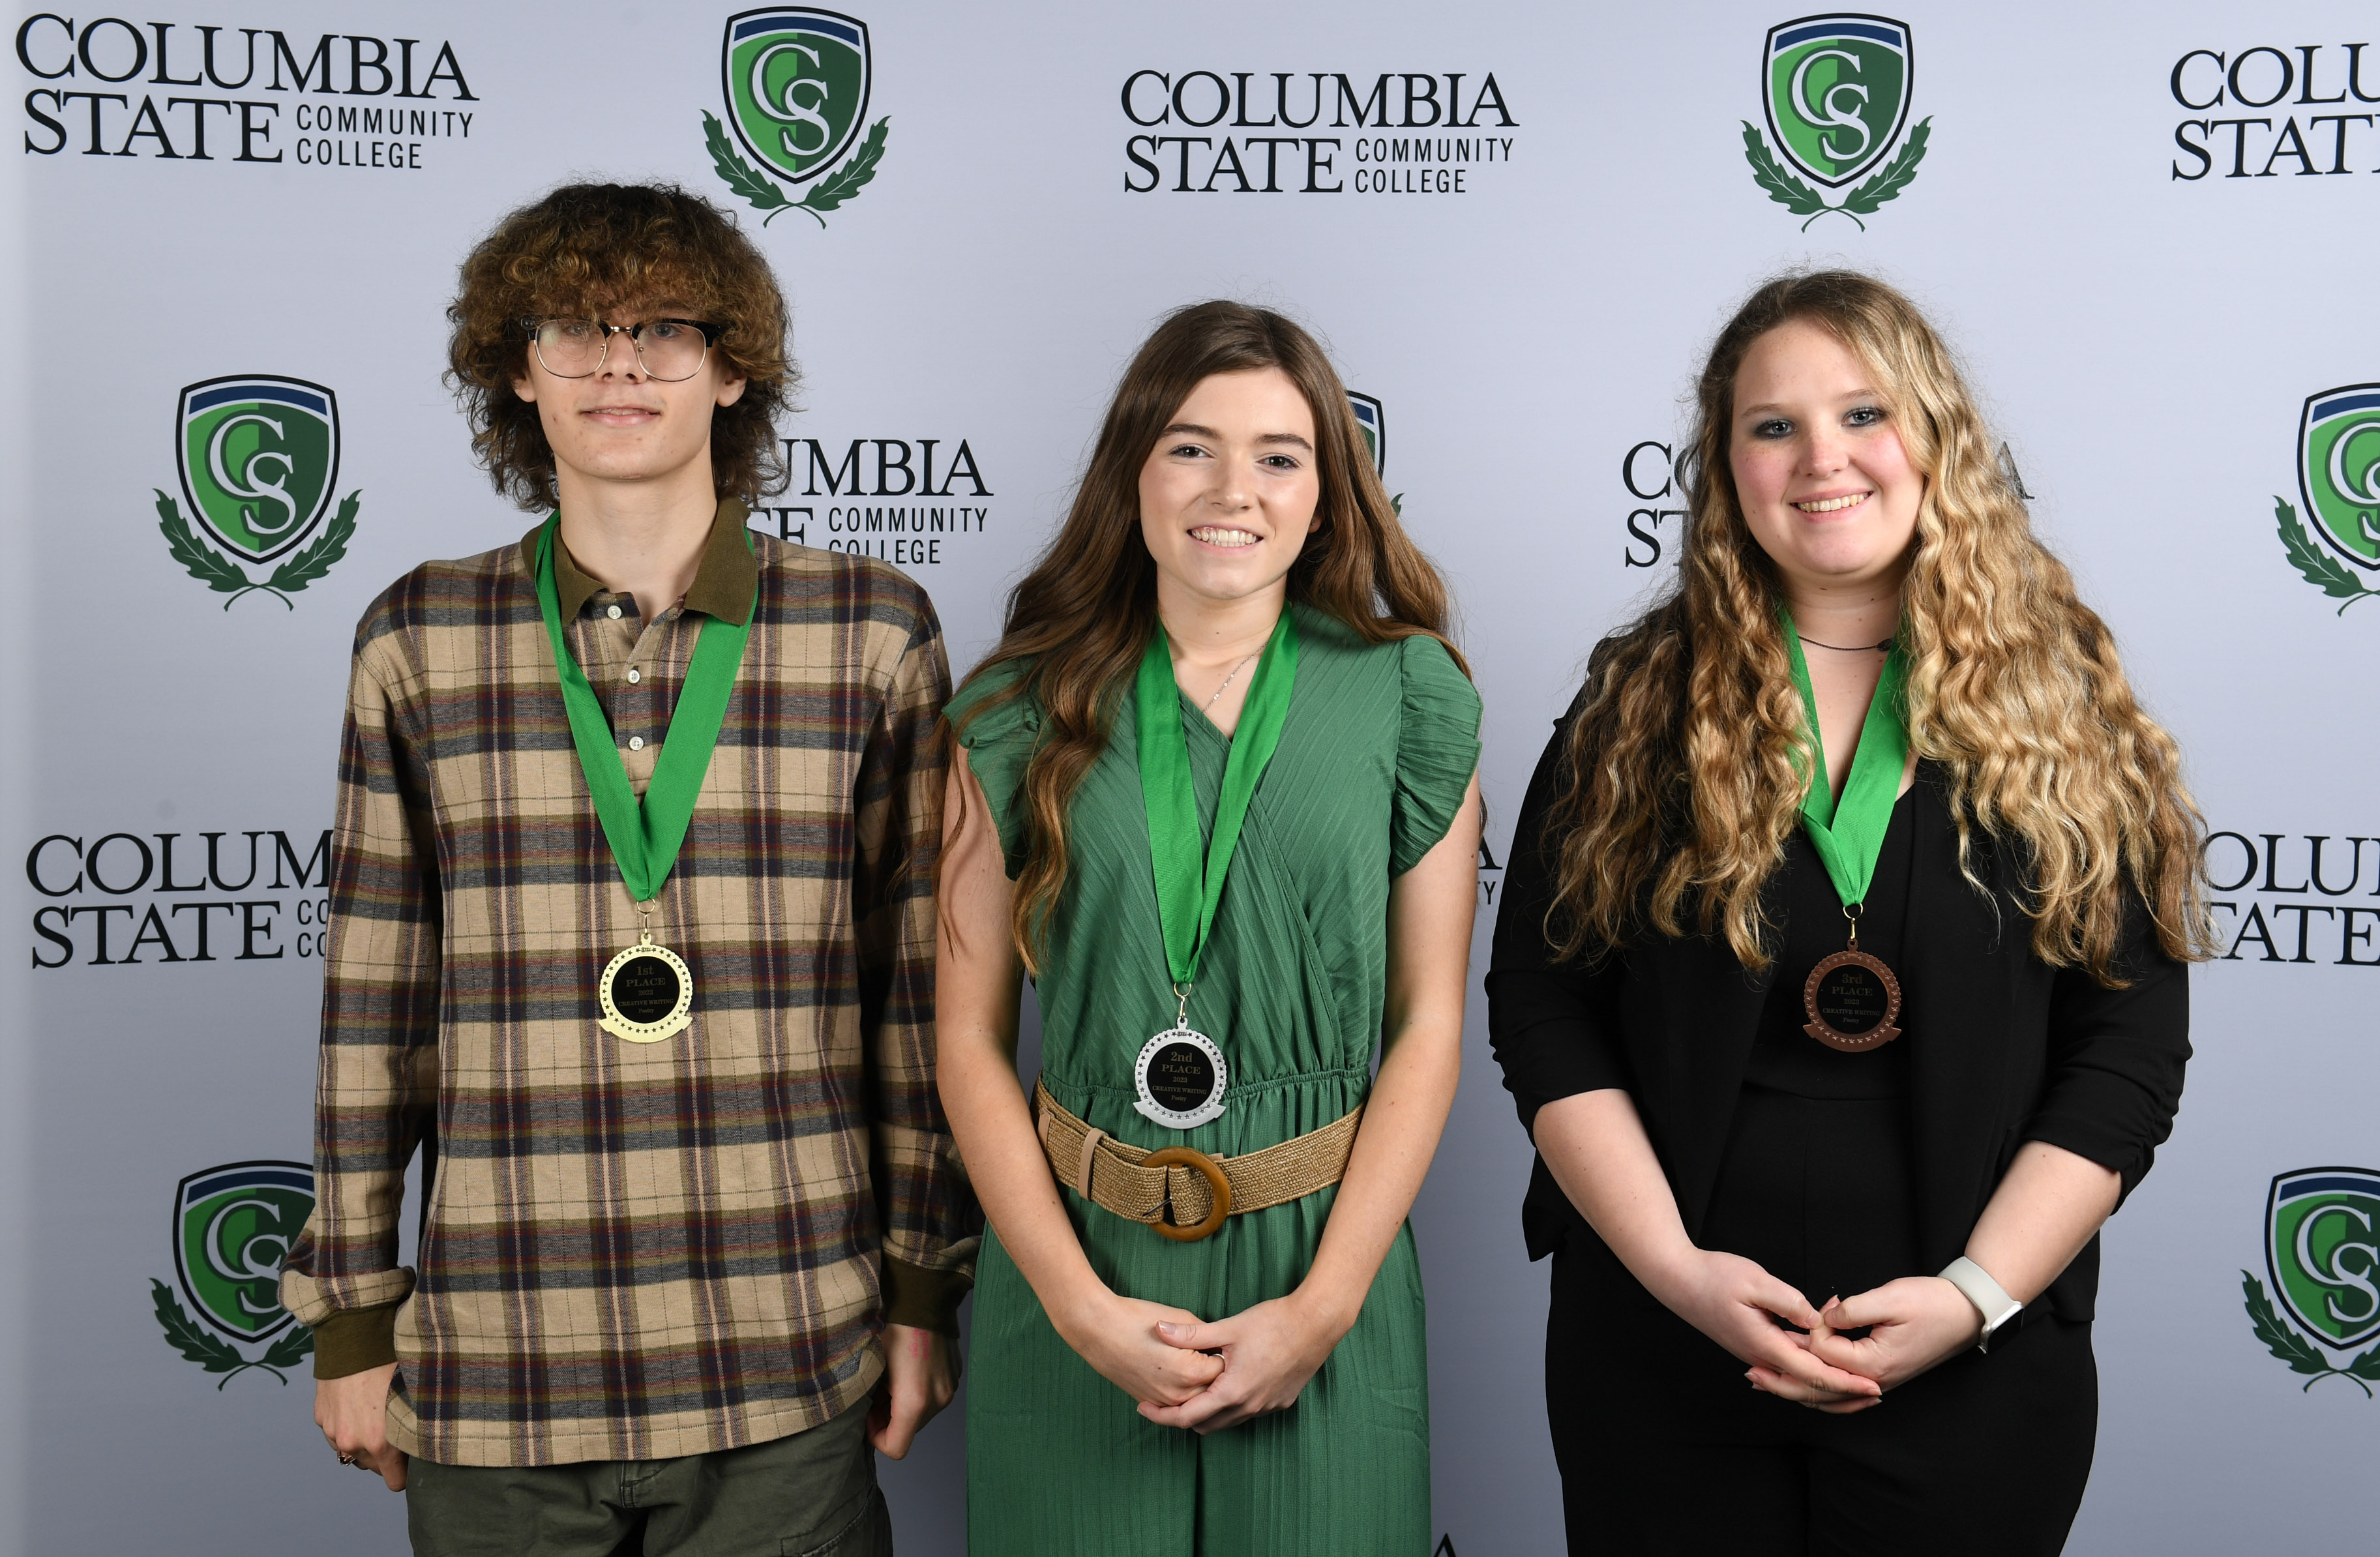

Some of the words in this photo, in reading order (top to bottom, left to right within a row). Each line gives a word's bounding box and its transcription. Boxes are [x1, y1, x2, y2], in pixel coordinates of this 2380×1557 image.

[16, 13, 480, 101] COLUMBIA
[1121, 70, 1520, 128] COLUMBIA
[25, 89, 283, 163] STATE
[297, 104, 473, 138] COMMUNITY
[297, 138, 422, 169] COLLEGE
[1356, 138, 1513, 162] COMMUNITY
[2172, 114, 2380, 181] STAT
[1124, 134, 1343, 193] STATE
[1355, 169, 1466, 193] COLLEGE
[828, 507, 988, 532] COMMUNITY
[32, 900, 284, 970] STATE
[625, 977, 666, 987] PLACE
[636, 965, 655, 975] 1st
[1841, 973, 1863, 984] 3rd
[1831, 986, 1873, 996] PLACE
[1161, 1063, 1201, 1075] PLACE
[1170, 1051, 1193, 1062] 2nd
